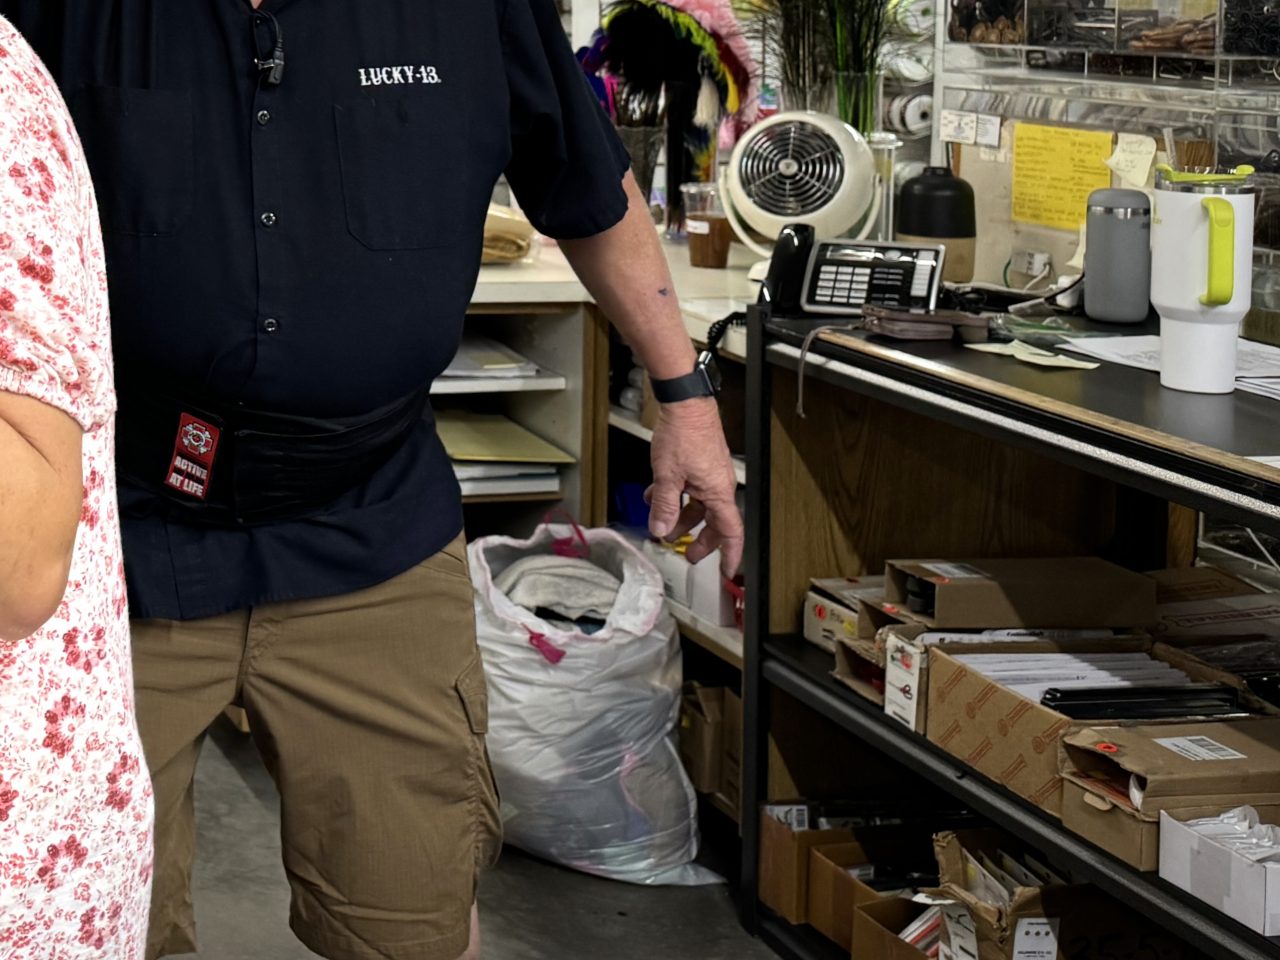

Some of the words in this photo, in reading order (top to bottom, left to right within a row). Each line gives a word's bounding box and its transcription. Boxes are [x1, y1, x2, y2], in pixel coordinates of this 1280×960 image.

[174, 455, 208, 480] ACTIVE
[169, 472, 183, 487] AT
[183, 478, 204, 497] LIFE
